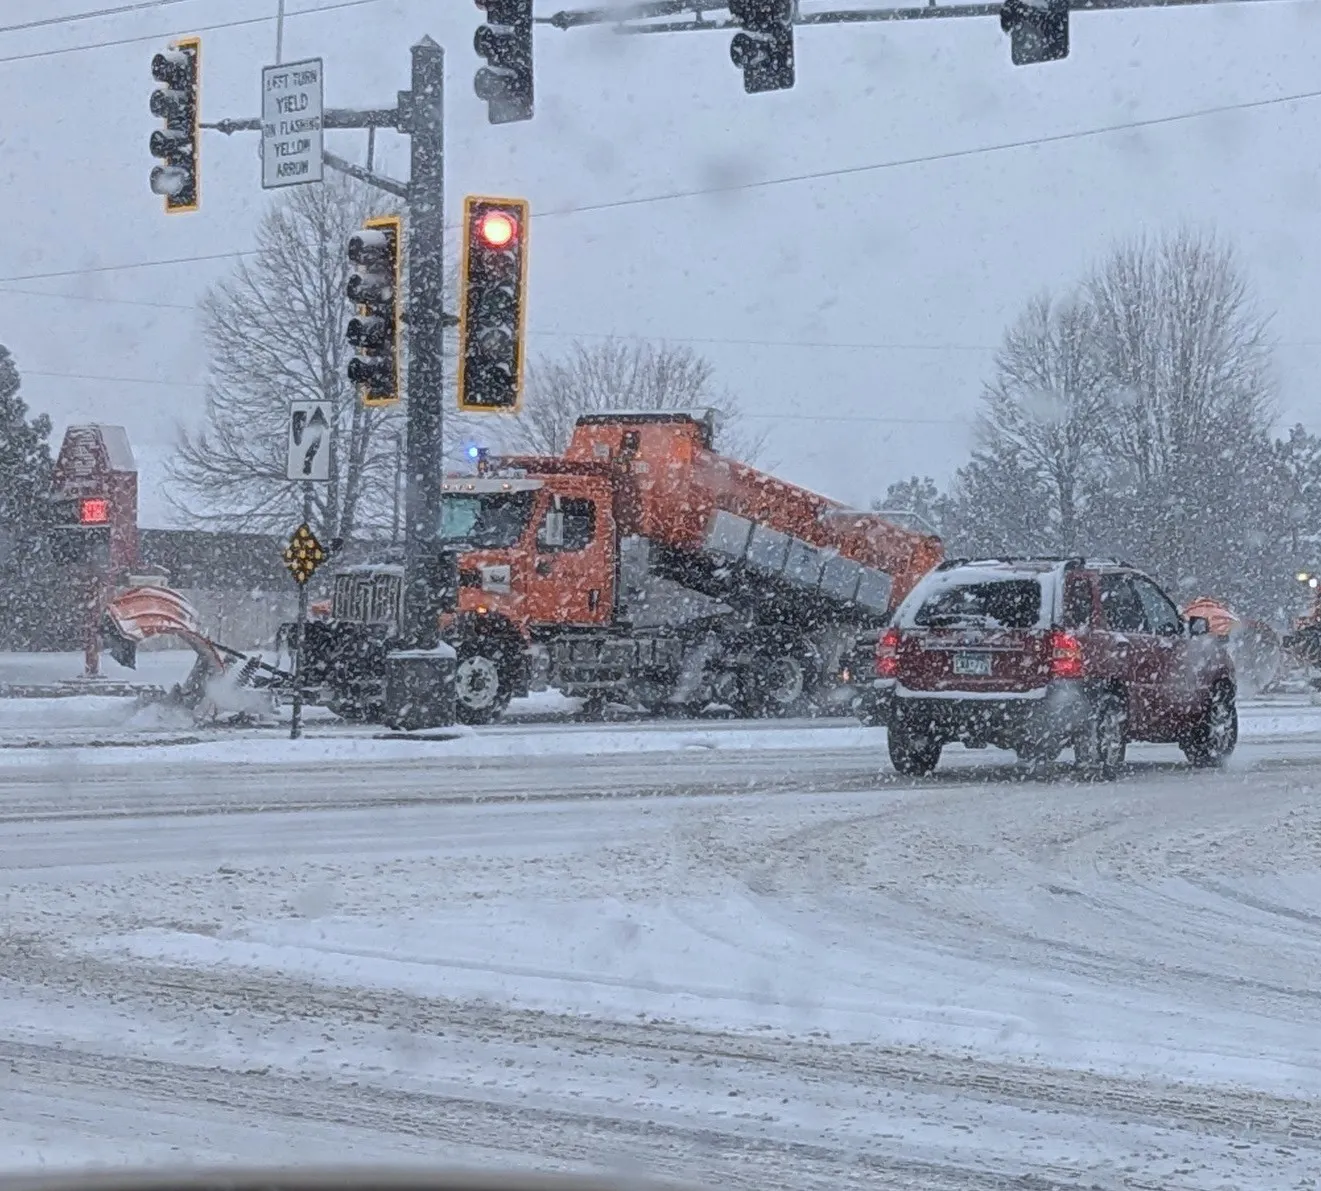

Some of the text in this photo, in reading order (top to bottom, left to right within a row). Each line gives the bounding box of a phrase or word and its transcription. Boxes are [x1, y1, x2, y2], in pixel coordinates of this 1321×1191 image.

[292, 70, 318, 87] TURN
[275, 93, 309, 114] YIELD
[263, 116, 320, 139] ON FLASHING
[274, 138, 311, 158] YELLOW
[276, 160, 309, 178] ARROW
